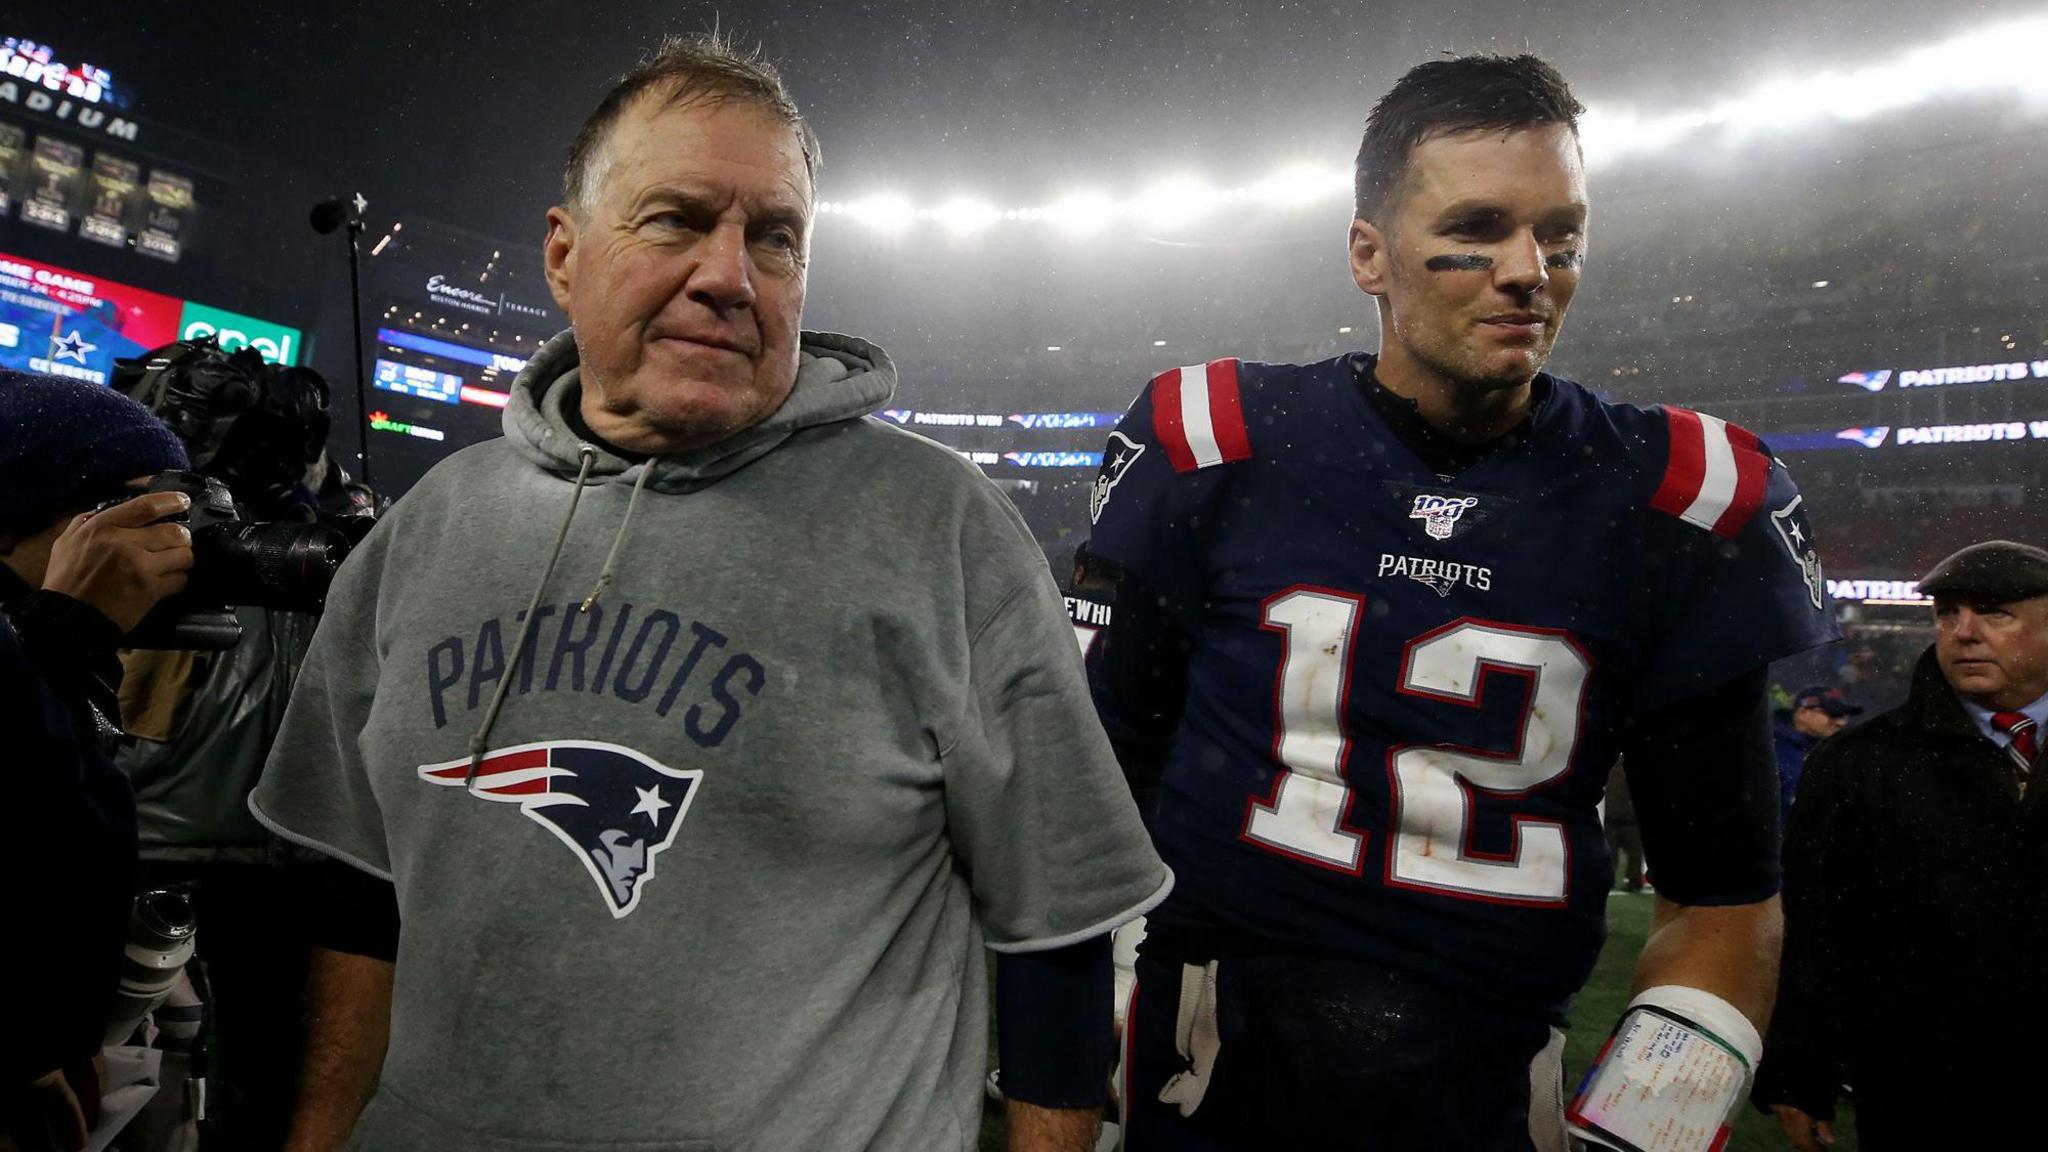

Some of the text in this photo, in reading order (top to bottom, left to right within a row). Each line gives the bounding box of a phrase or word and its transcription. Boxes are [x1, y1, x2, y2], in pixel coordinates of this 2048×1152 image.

[35, 269, 95, 296] GAME
[426, 273, 497, 307] Encore
[505, 301, 548, 318] TERRACE
[1898, 362, 2029, 388] PATRIOTS
[914, 412, 1003, 428] PATRIOTS WIN
[1896, 422, 2027, 446] PATRIOTS
[1378, 553, 1492, 592] PATRIOTS
[427, 602, 766, 748] PATRIOTS
[1239, 583, 1599, 908] 12
